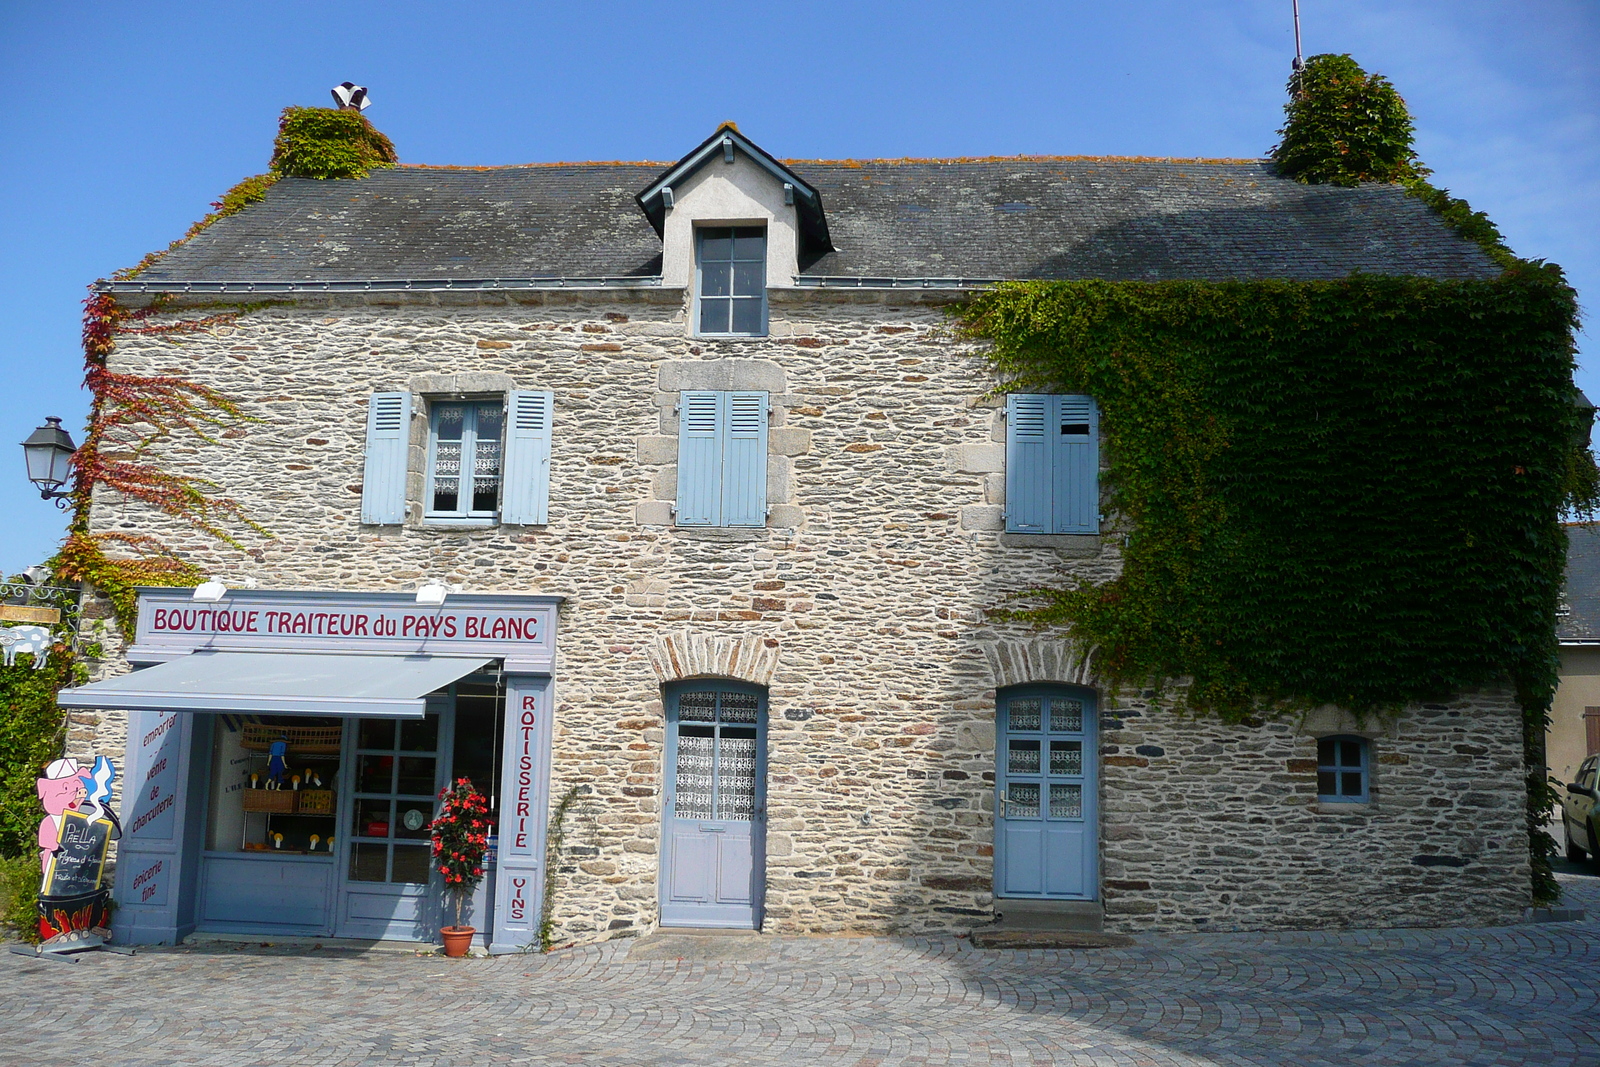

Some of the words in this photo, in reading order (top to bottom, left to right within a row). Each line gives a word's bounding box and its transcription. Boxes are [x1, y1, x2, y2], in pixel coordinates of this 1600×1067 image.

[154, 609, 259, 632] BOUTIQUE
[265, 611, 369, 636] TRAITEUR
[373, 614, 396, 637] du
[402, 615, 457, 638] PAYS
[465, 616, 538, 640] BLANC
[143, 713, 177, 747] emporter
[146, 758, 167, 781] vente
[515, 696, 535, 848] ROTISSERIE
[150, 785, 160, 801] de
[132, 793, 174, 833] charcuterie
[132, 859, 163, 890] épicerie
[141, 882, 157, 903] fine
[511, 878, 526, 920] VINS
